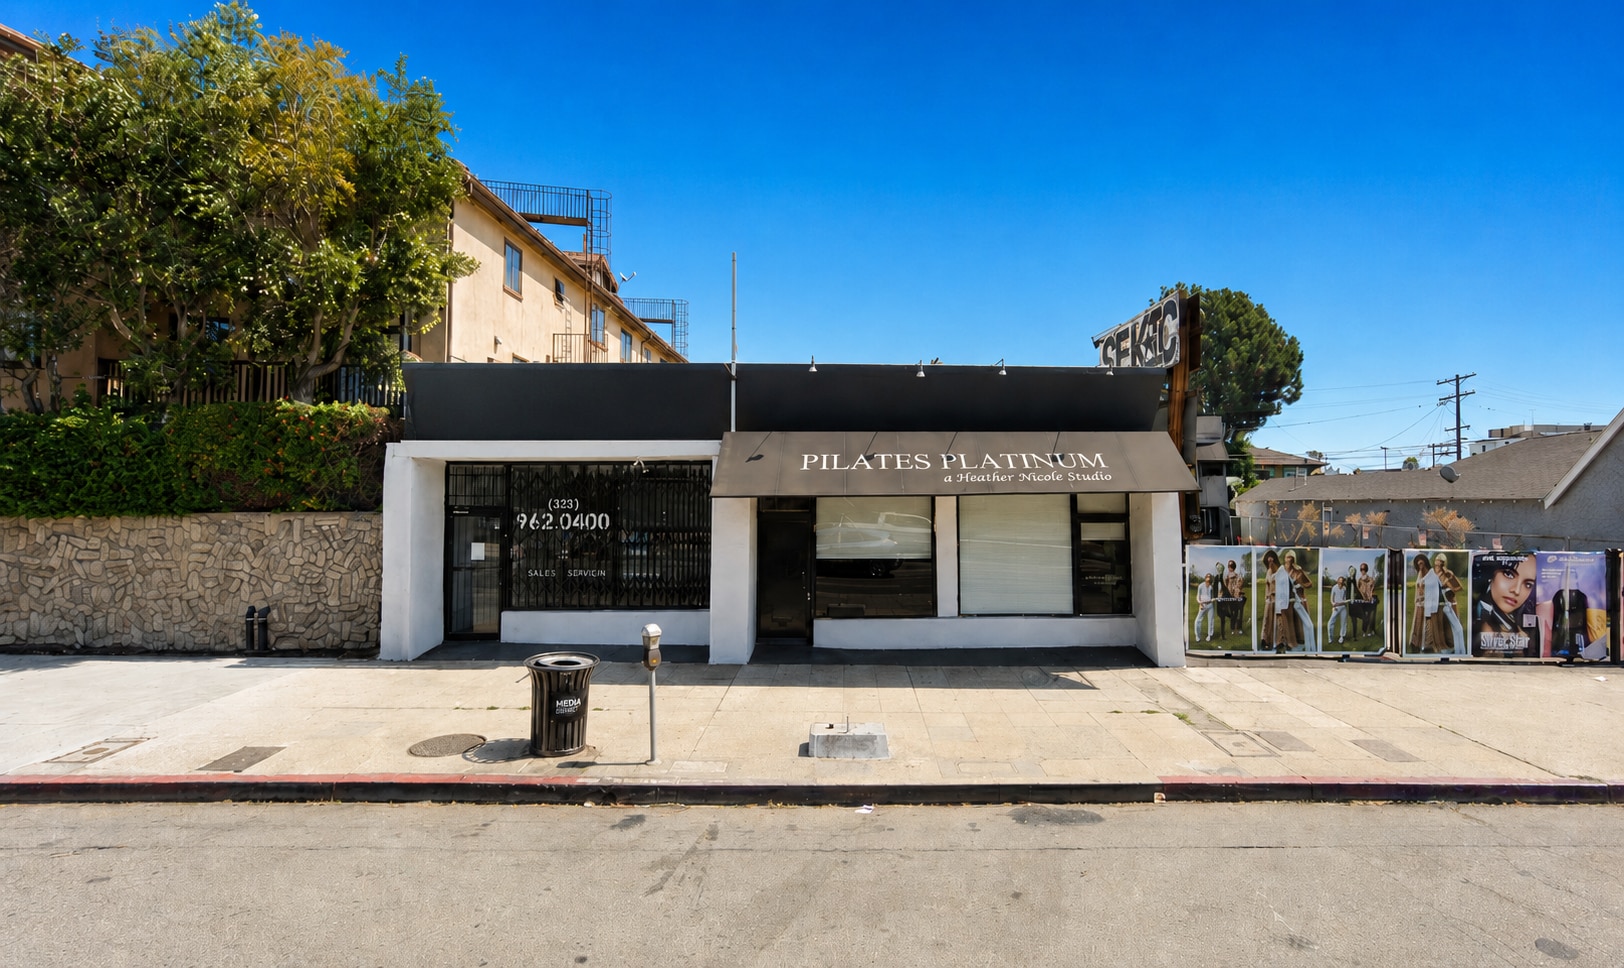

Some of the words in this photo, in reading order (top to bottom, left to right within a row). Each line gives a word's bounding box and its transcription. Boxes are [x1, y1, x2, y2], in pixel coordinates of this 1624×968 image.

[800, 453, 931, 470] PILATES
[939, 453, 1109, 470] PLATINUM
[943, 474, 953, 483] a
[956, 471, 1015, 482] Heather
[1018, 471, 1063, 482] Nicole
[1067, 471, 1112, 482] Studio
[548, 498, 579, 511] (323)
[516, 512, 610, 530] 962.0400
[527, 569, 556, 577] SALES
[556, 698, 581, 708] MEDIA
